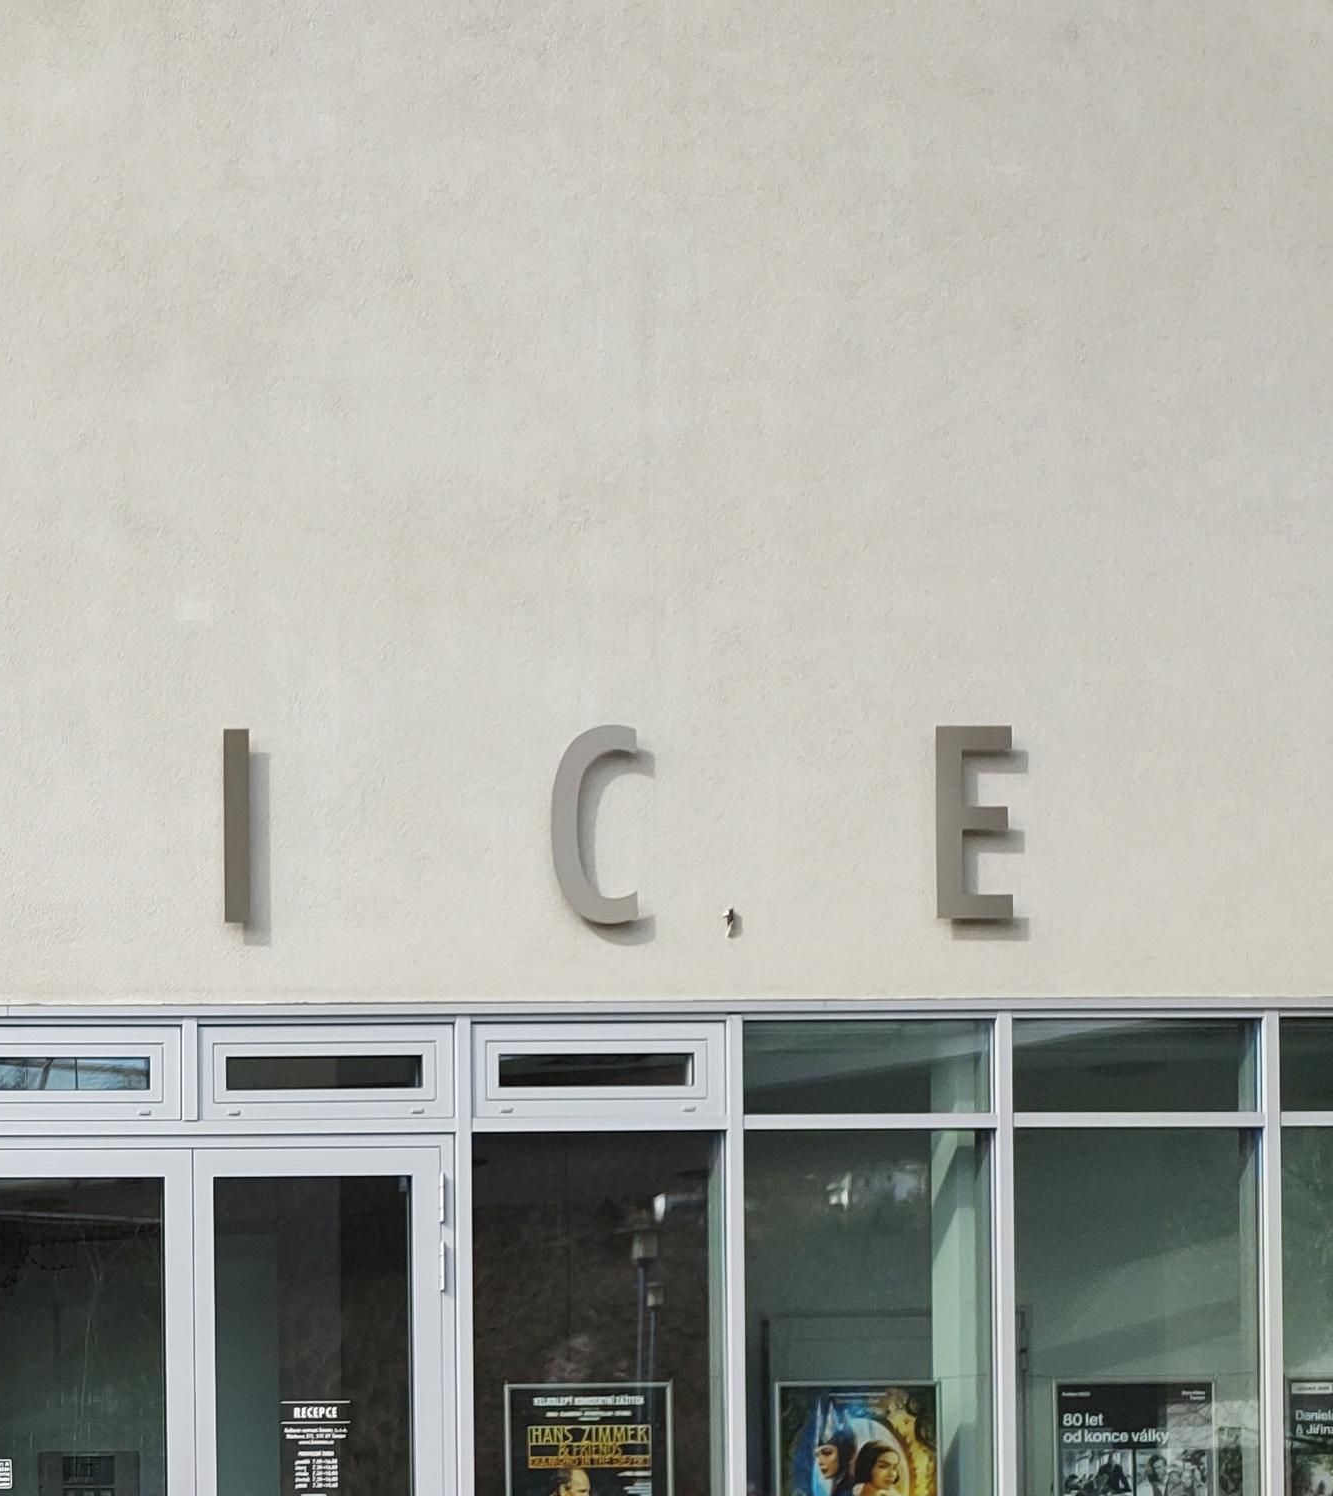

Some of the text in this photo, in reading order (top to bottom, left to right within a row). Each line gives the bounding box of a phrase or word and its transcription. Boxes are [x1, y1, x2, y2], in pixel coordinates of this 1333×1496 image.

[293, 1406, 338, 1419] RECEPCE
[1062, 1412, 1104, 1427] 80 let
[1295, 1409, 1333, 1421] Daniel
[533, 1426, 649, 1443] HANS ZIMMER
[1063, 1428, 1171, 1444] od konce války
